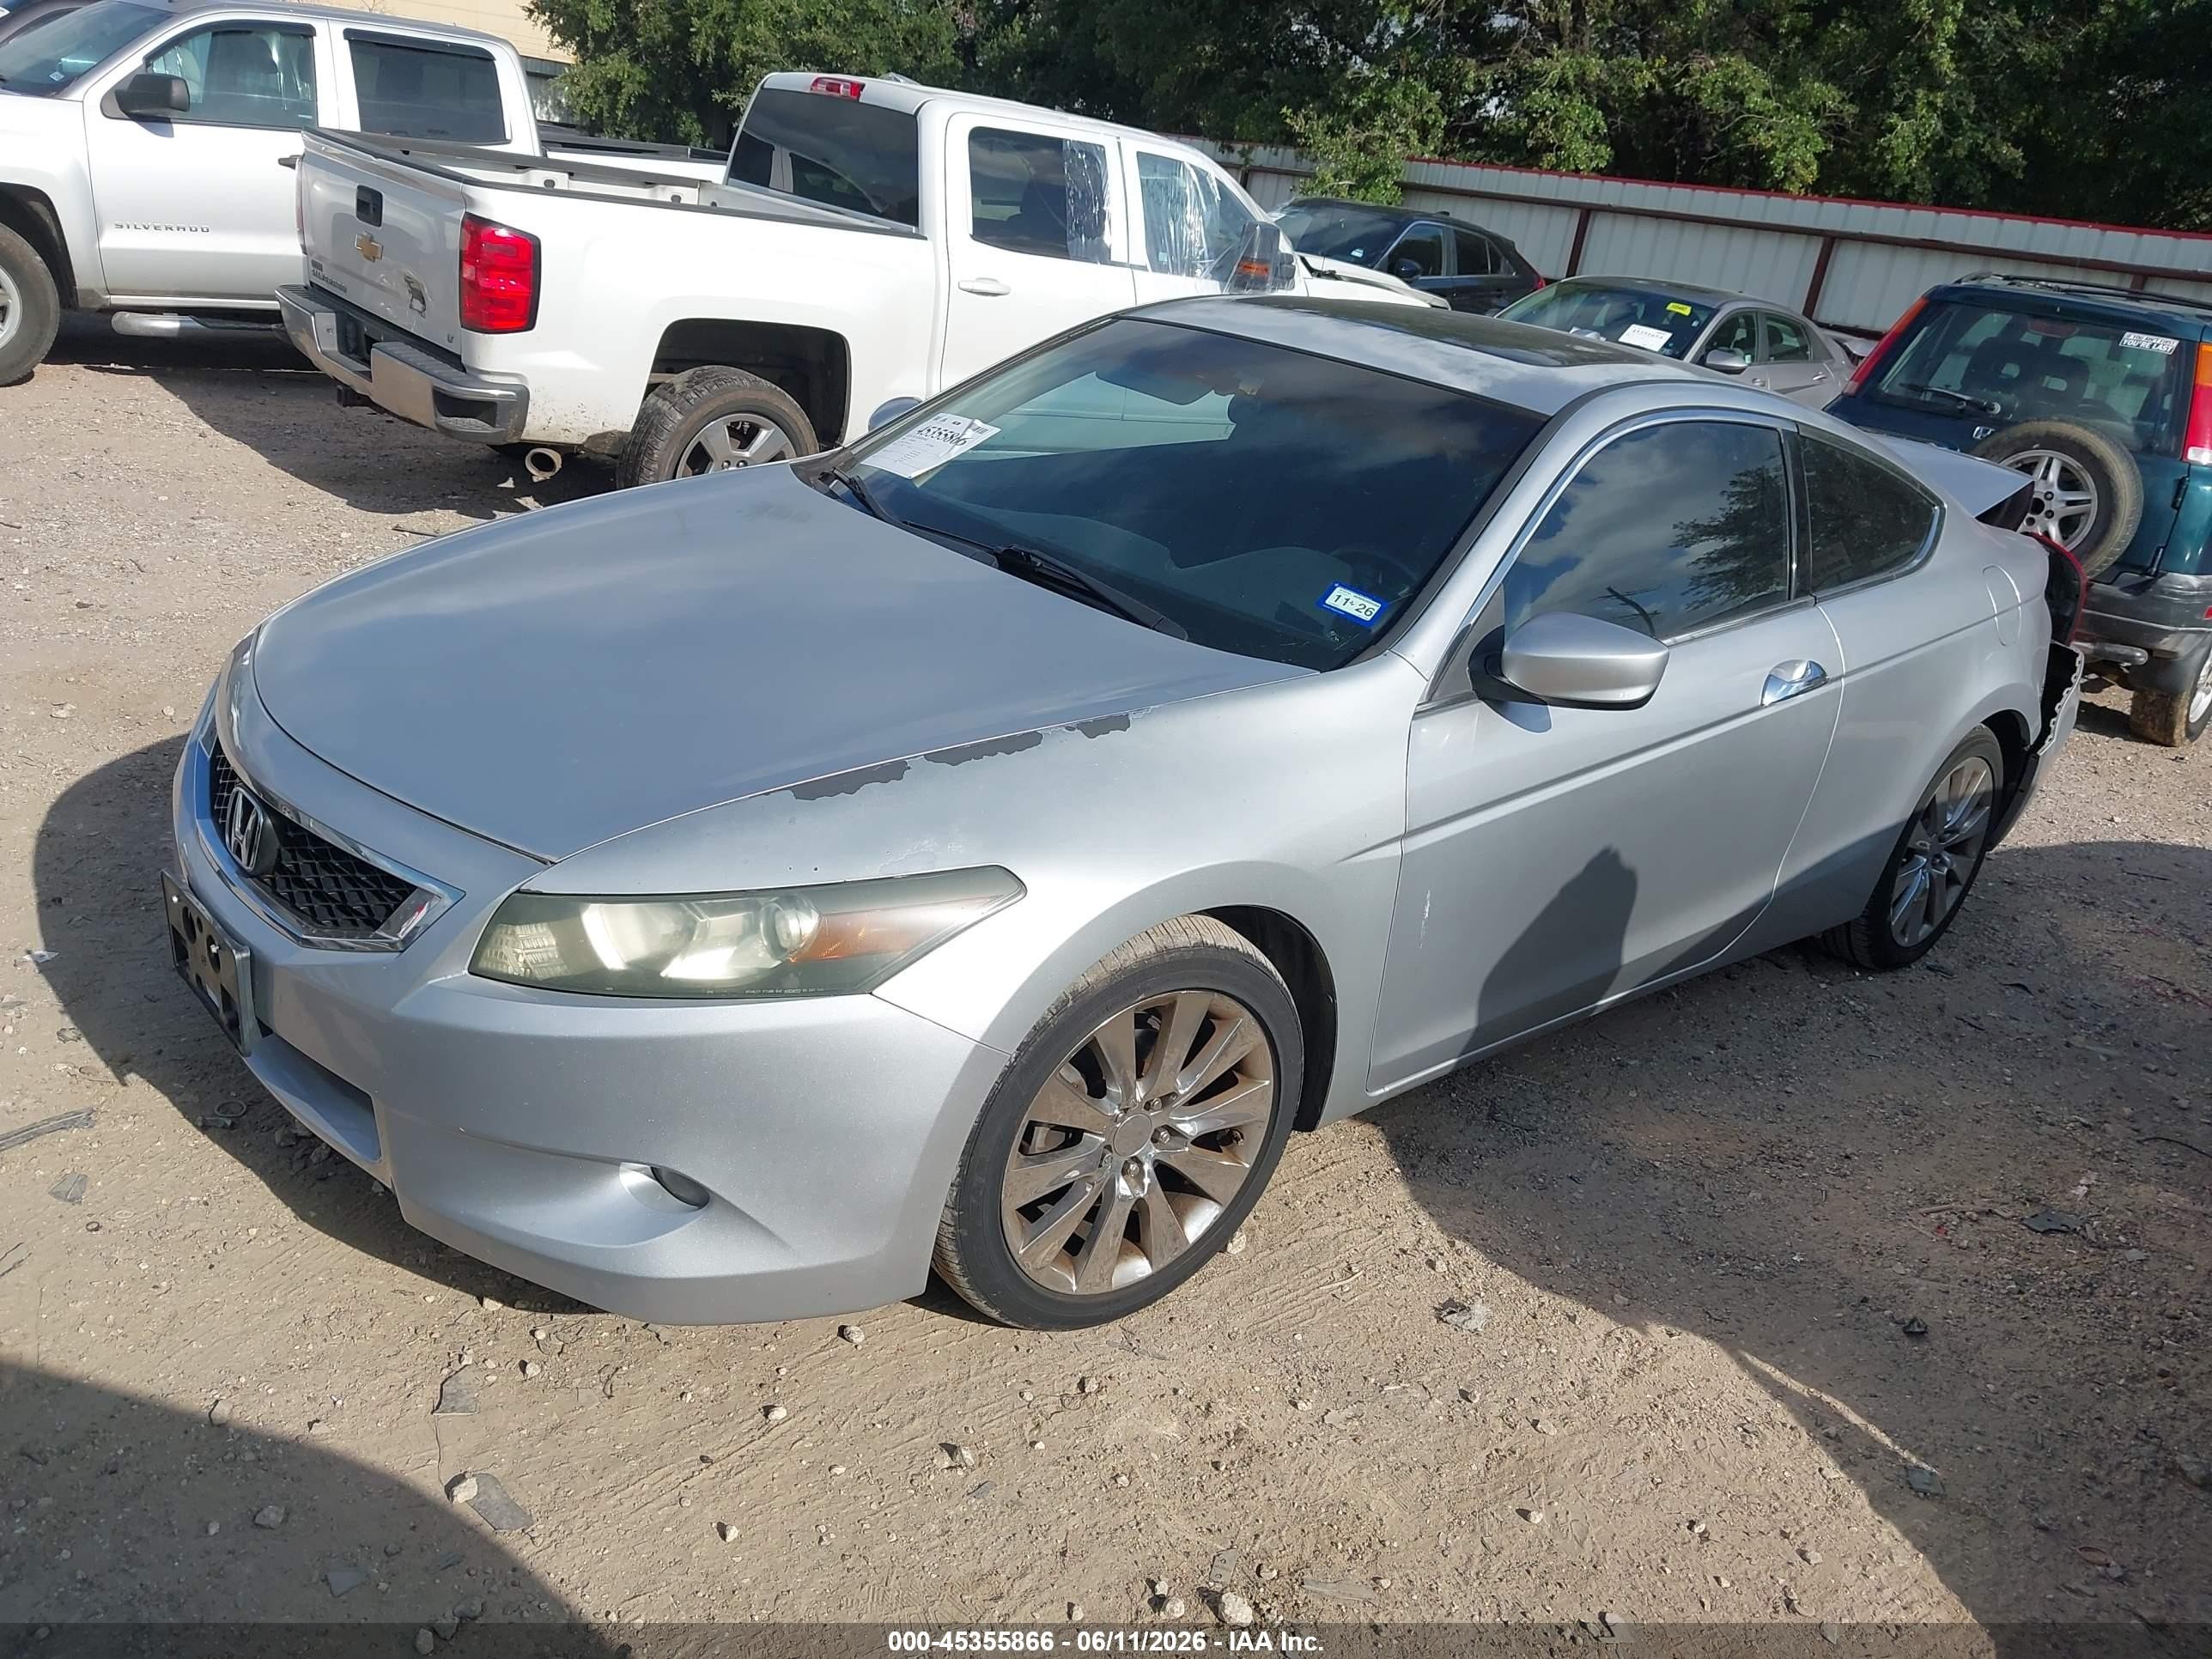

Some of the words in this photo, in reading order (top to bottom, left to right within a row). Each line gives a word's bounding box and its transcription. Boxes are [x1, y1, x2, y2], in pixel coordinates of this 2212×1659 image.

[114, 221, 210, 233] SILVERADO
[2122, 338, 2152, 349] YOU'RE
[2151, 343, 2173, 353] LAST
[1354, 603, 1376, 617] 26
